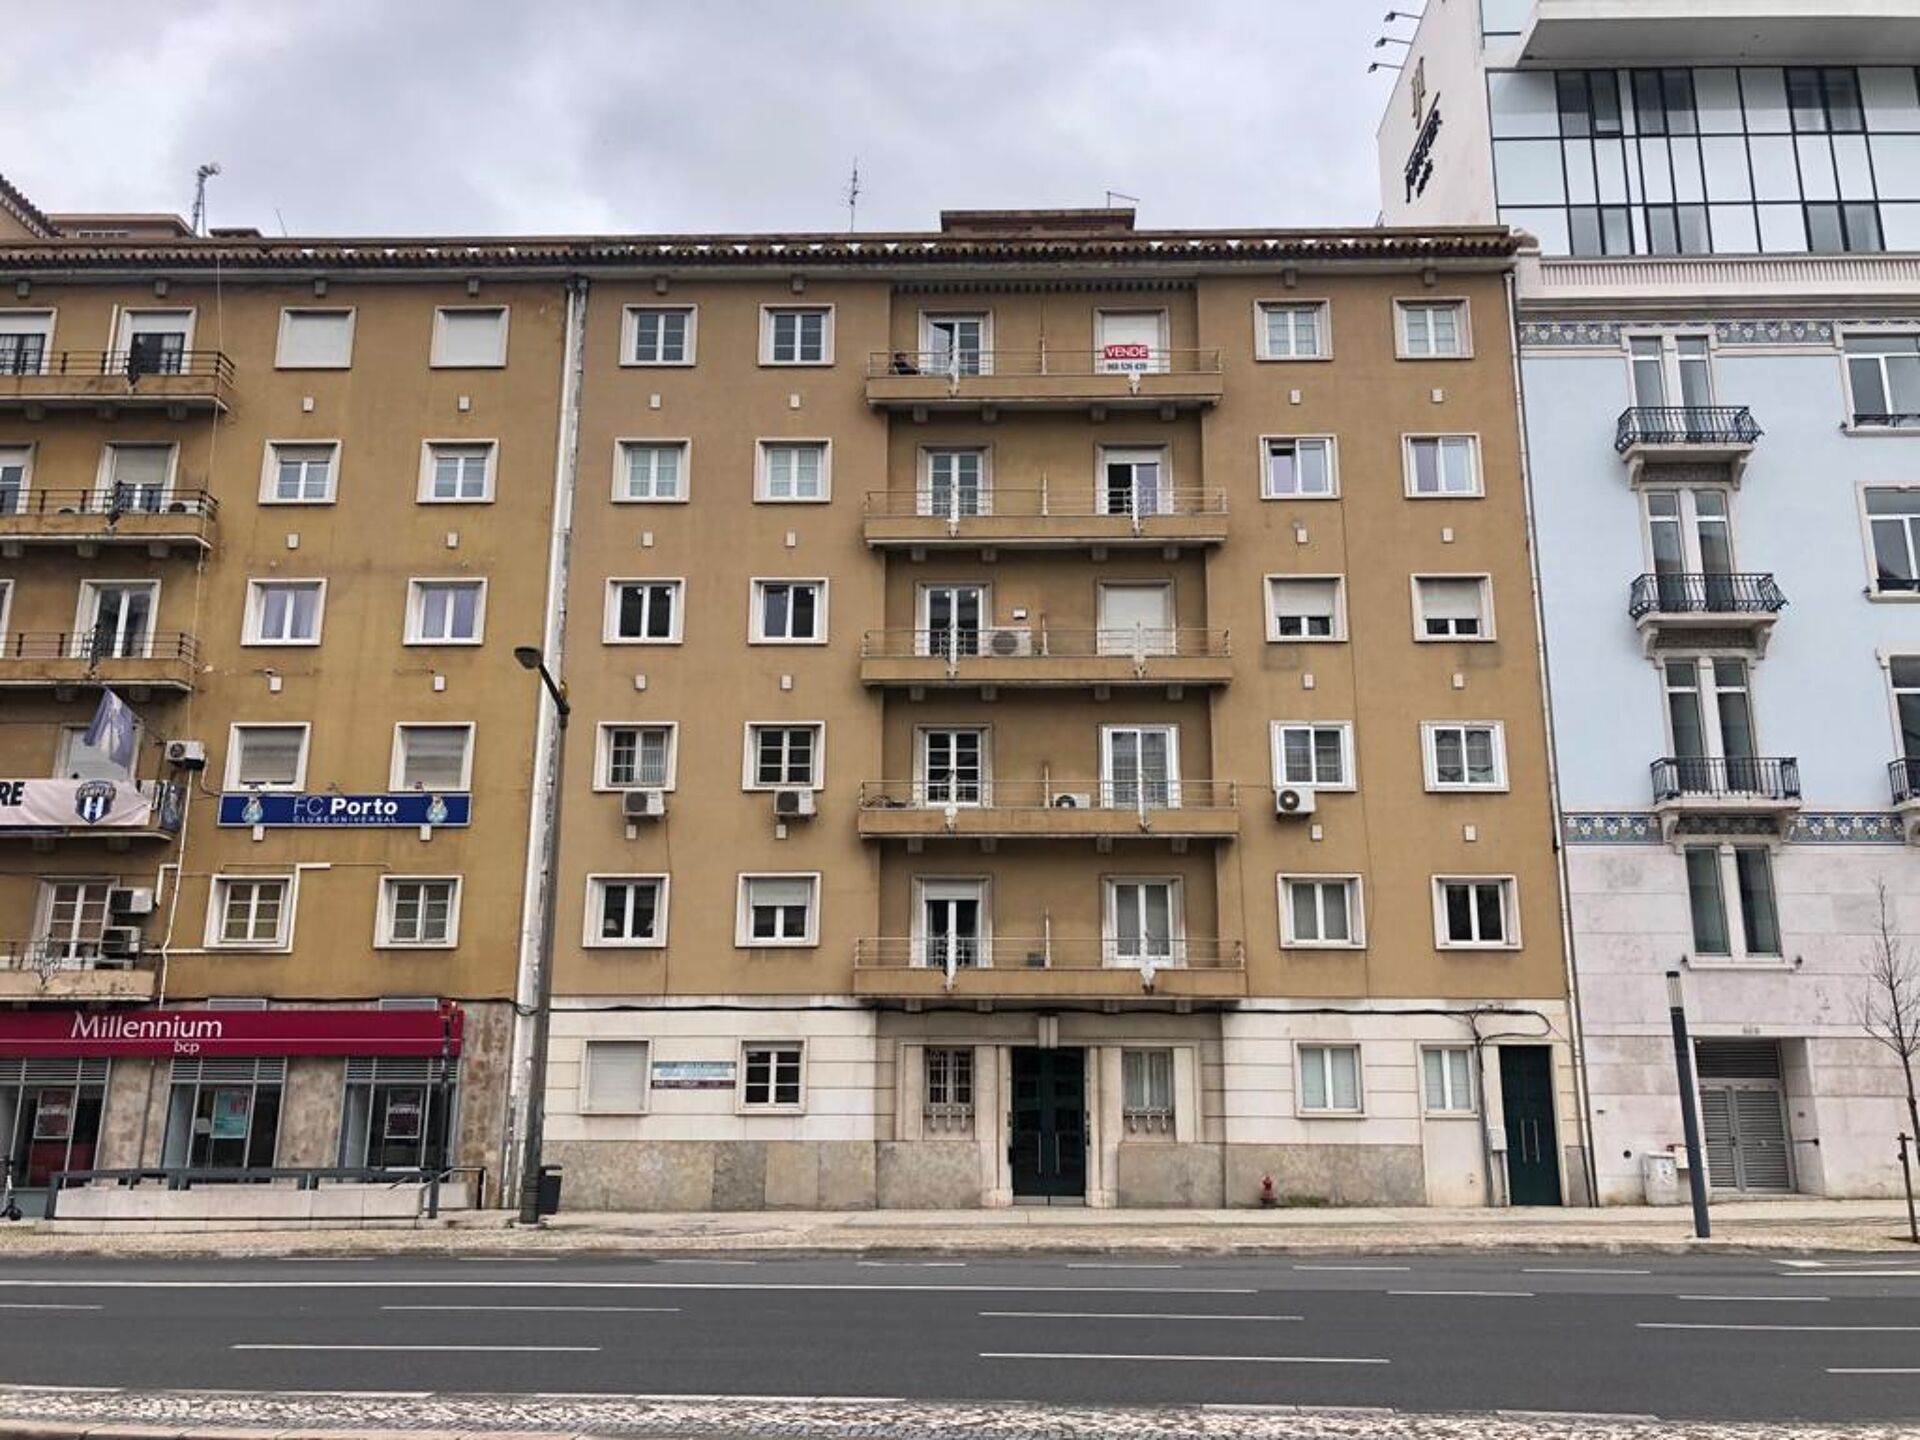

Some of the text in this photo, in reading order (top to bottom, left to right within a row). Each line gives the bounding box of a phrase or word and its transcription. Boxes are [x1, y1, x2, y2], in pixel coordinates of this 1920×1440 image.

[1105, 346, 1147, 357] VENDE
[293, 796, 398, 816] FC Porto
[71, 1011, 222, 1038] Millennium
[174, 1041, 200, 1055] bcp
